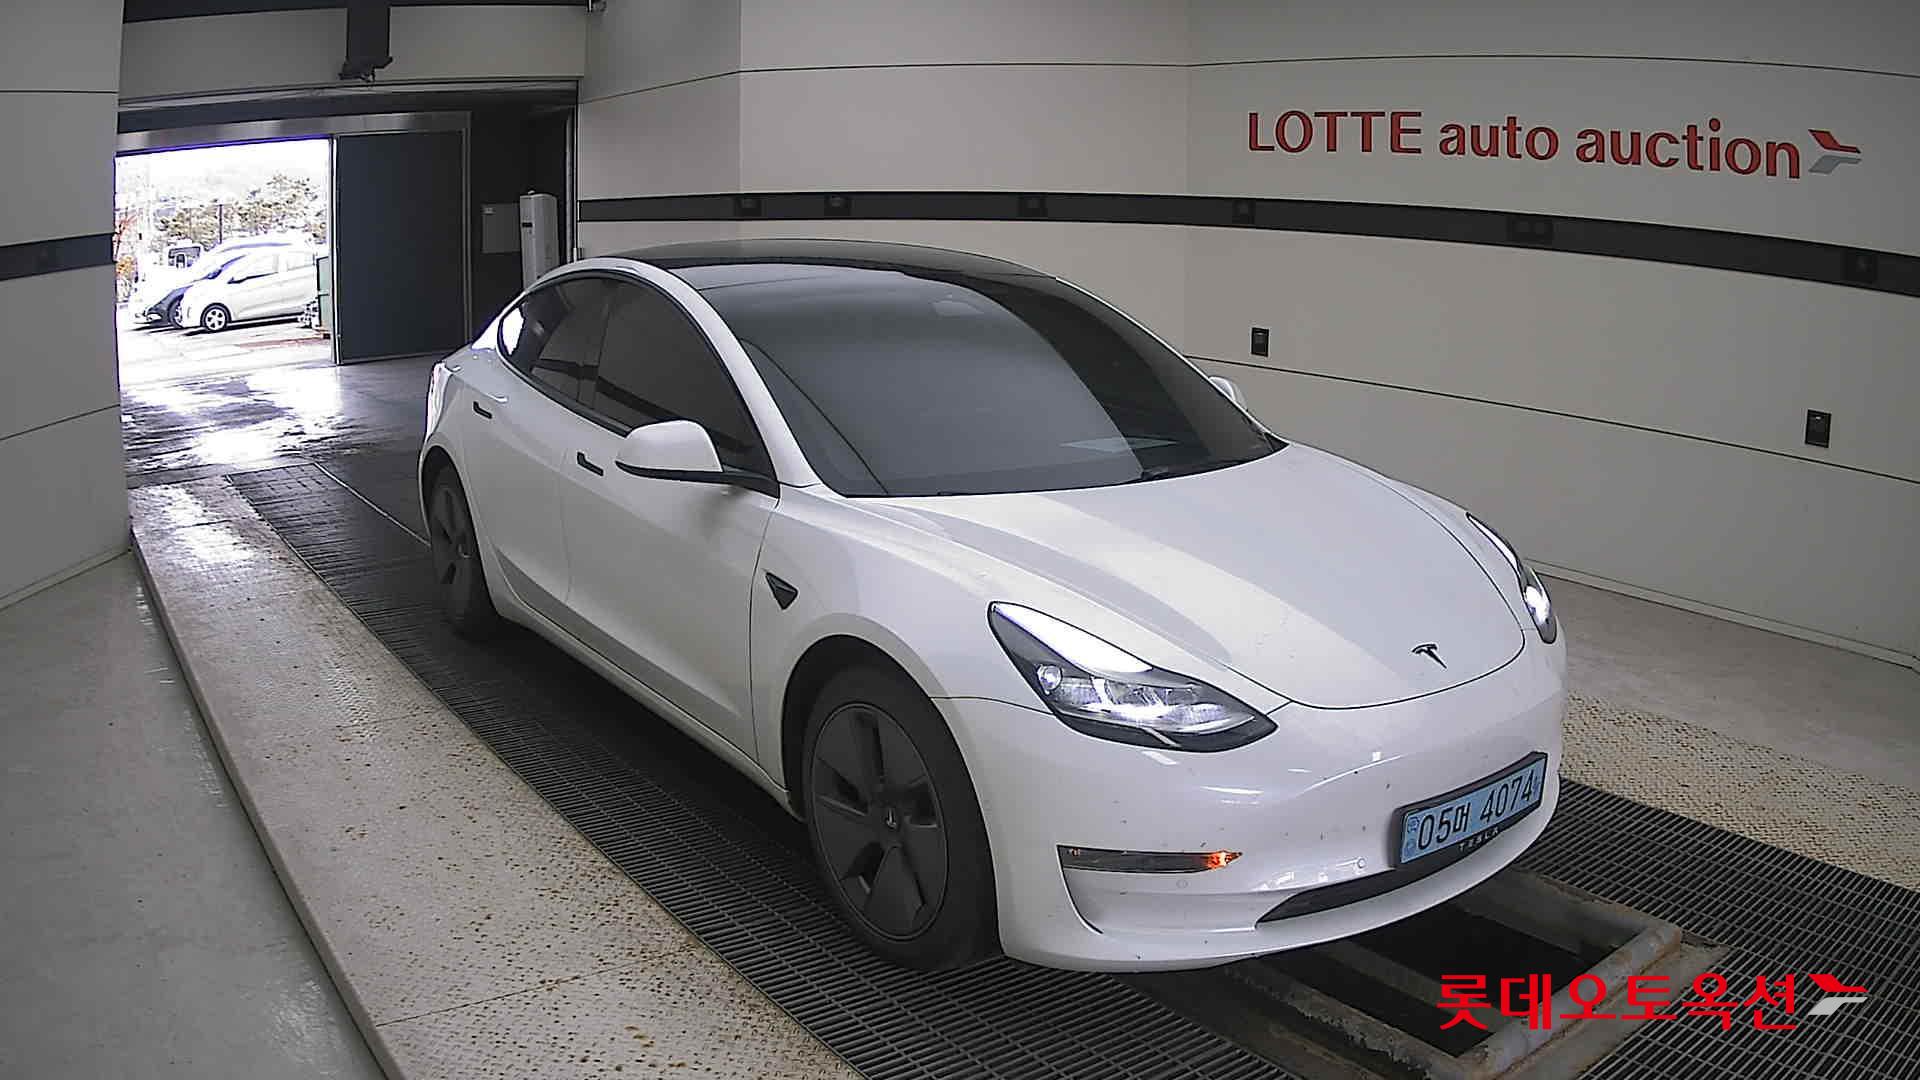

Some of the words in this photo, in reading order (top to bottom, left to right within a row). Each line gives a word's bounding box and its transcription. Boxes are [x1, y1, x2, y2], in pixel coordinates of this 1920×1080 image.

[1248, 111, 1423, 155] LOTTE
[1439, 115, 1560, 161] auto
[1575, 118, 1801, 179] auction
[1417, 801, 1471, 850] 05머
[1479, 769, 1535, 824] 4074
